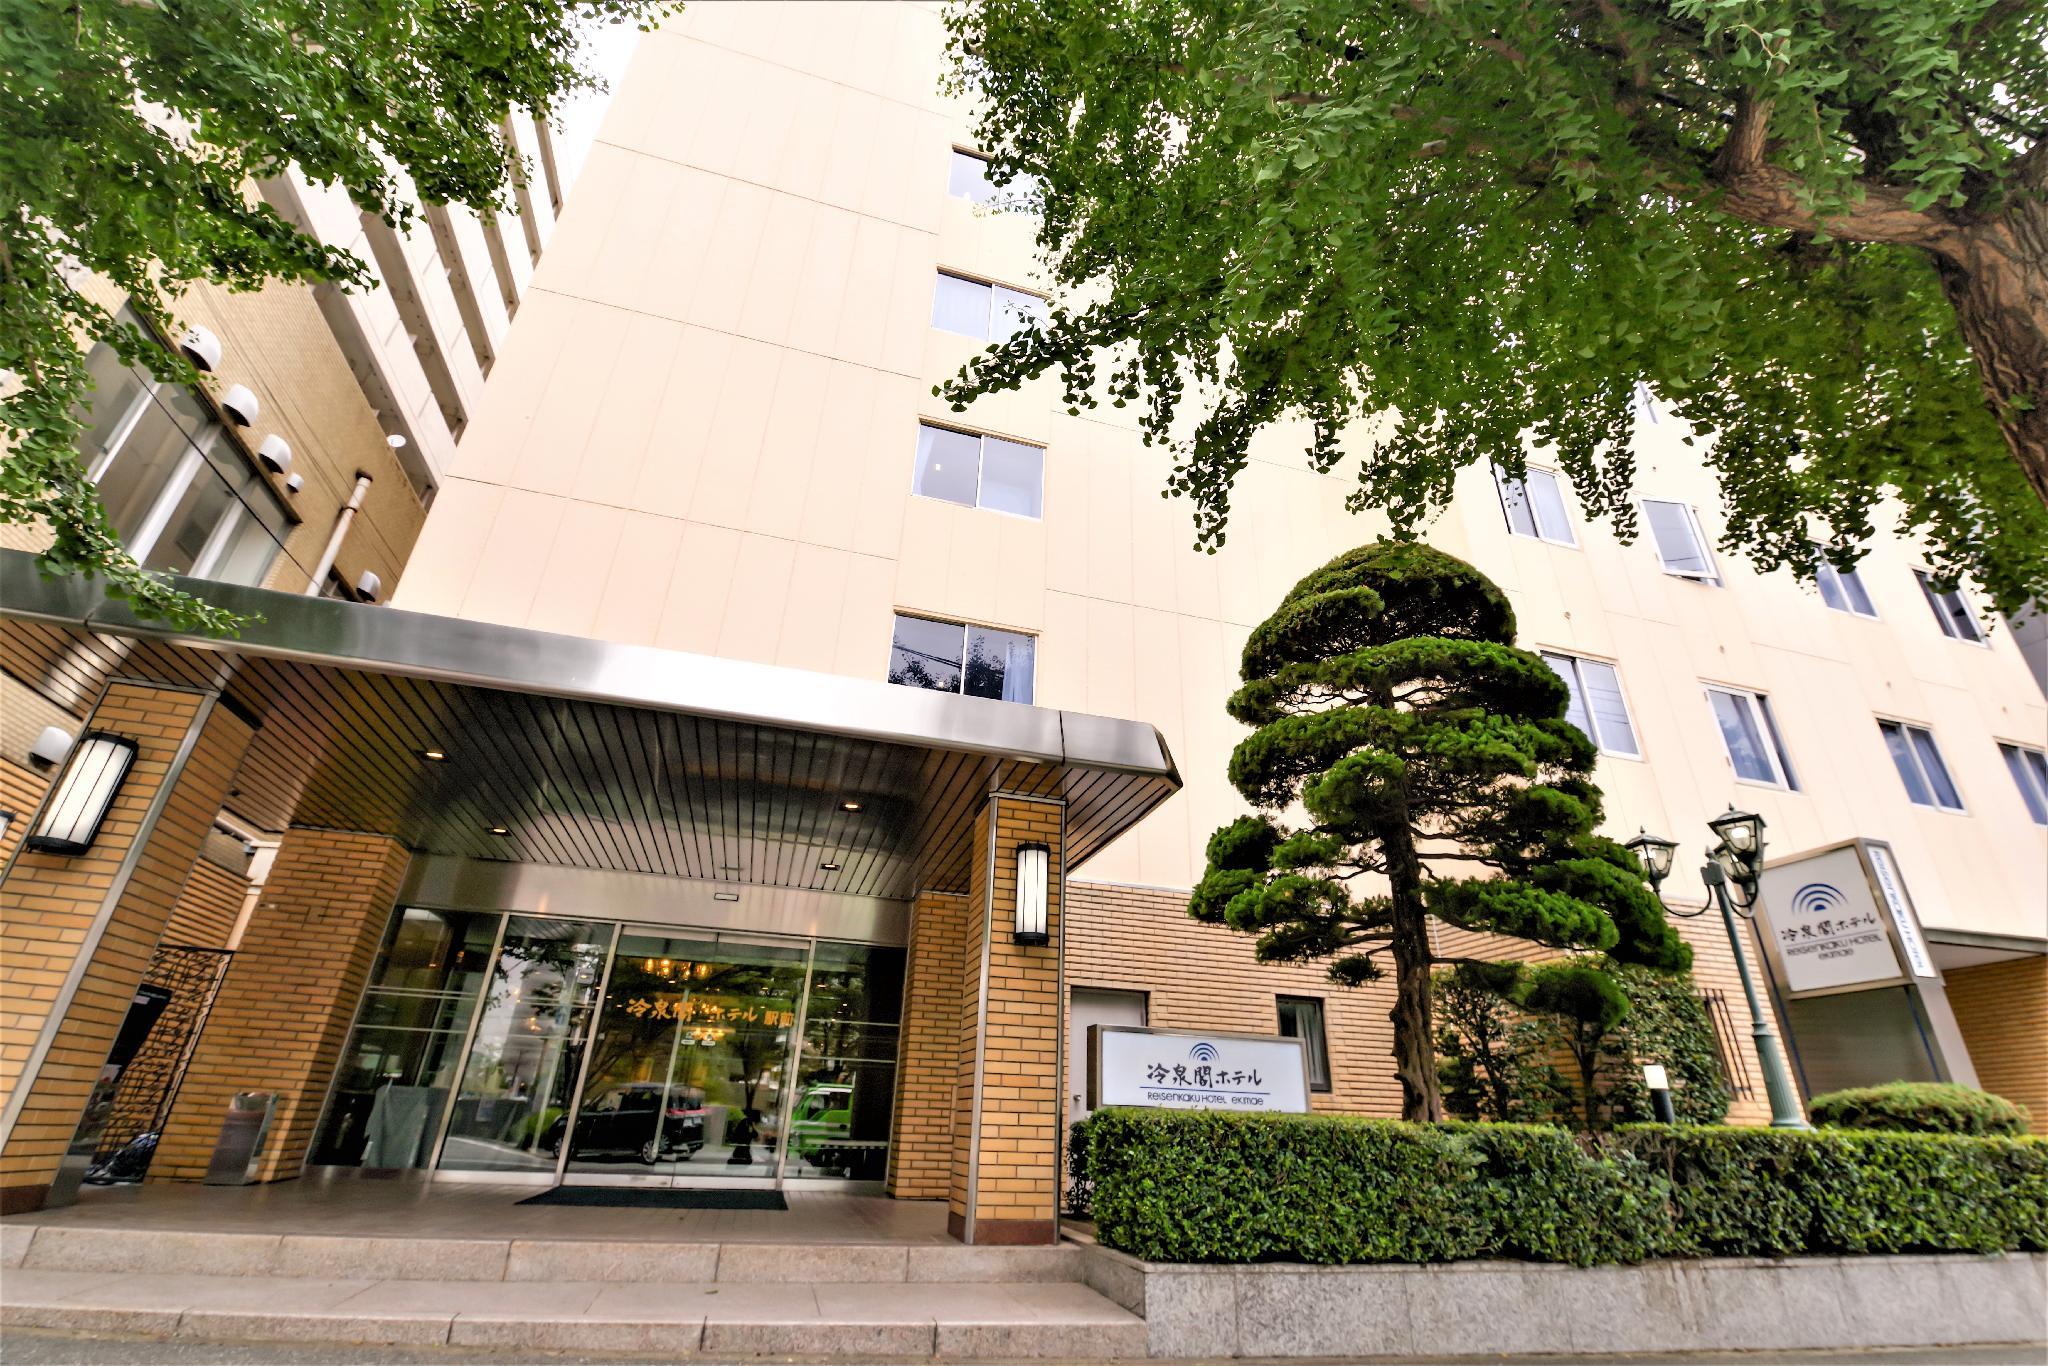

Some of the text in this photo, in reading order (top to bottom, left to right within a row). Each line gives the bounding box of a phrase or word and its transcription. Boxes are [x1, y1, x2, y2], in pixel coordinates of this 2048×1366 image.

[1781, 912, 1876, 941] 冷泉閣ホテル
[764, 1010, 795, 1029] 駅前
[1147, 1063, 1262, 1088] 冷泉閣ホテル
